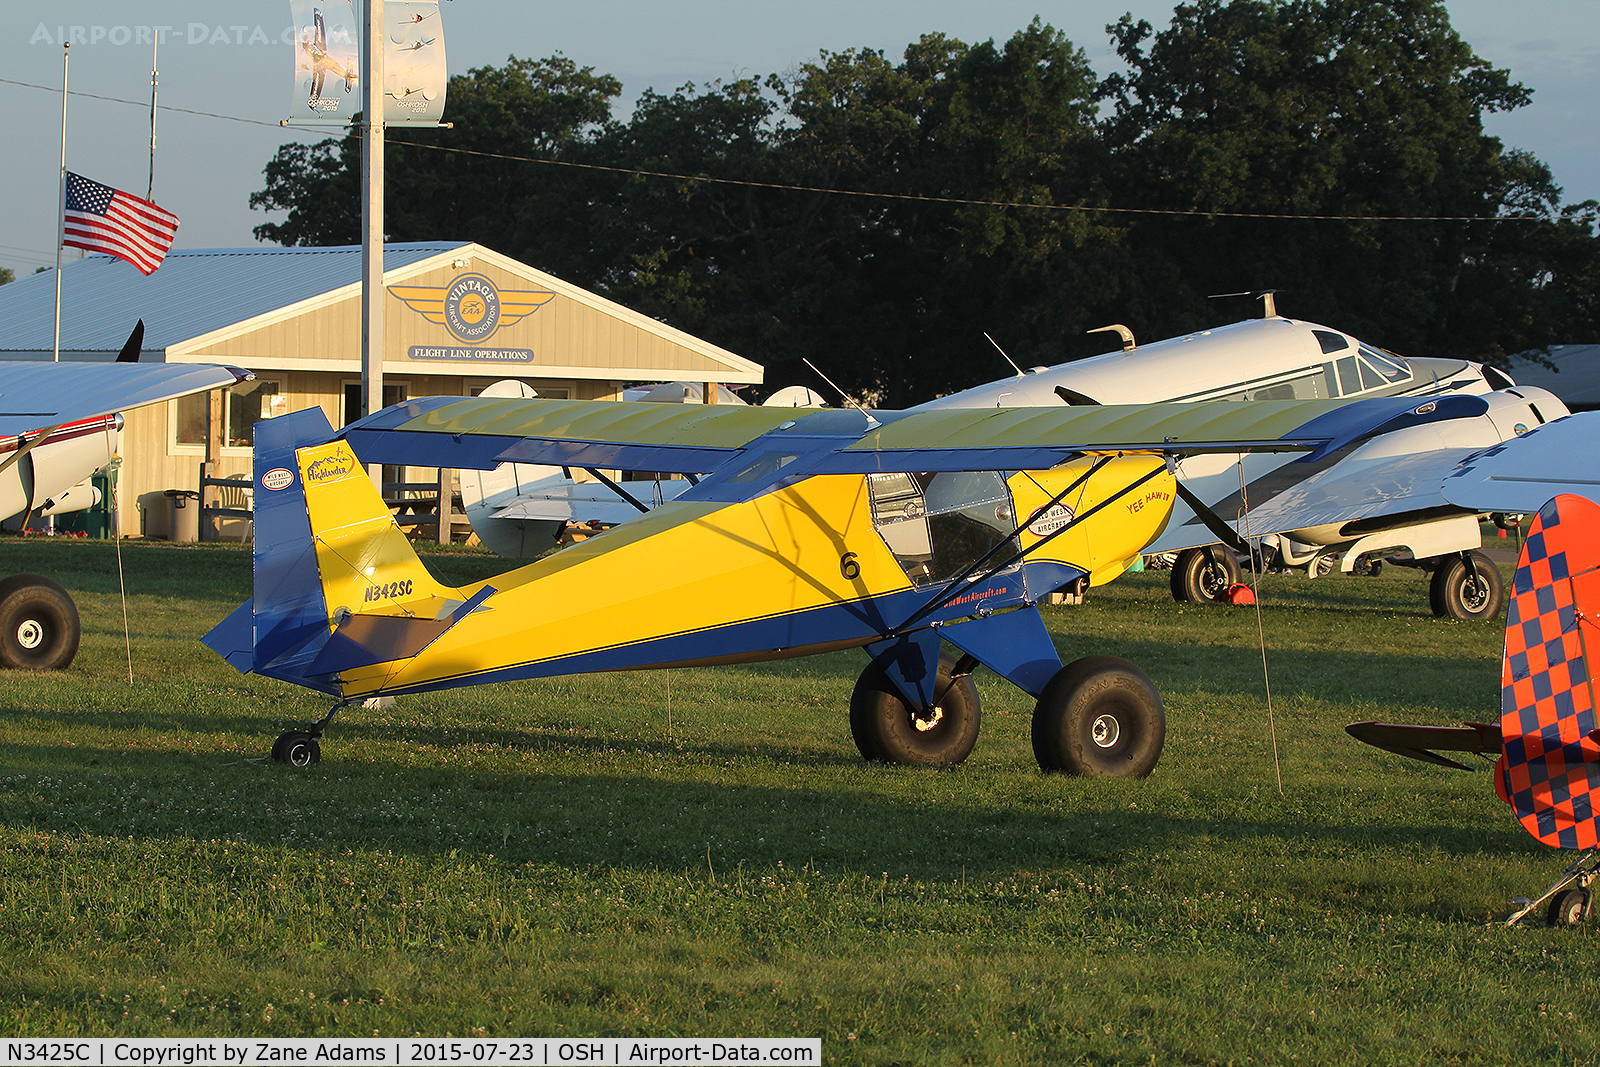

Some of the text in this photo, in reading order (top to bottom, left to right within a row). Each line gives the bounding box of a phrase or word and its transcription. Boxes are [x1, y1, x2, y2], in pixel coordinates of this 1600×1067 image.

[449, 280, 496, 303] VINTAGE
[449, 303, 496, 336] AIRCRAFT ASSOCIATION
[461, 307, 480, 315] EAA
[414, 348, 528, 360] FLIGHT LINE OPERATIONS
[1125, 498, 1144, 514] YEE
[1145, 491, 1162, 503] HAW
[840, 552, 861, 580] 6
